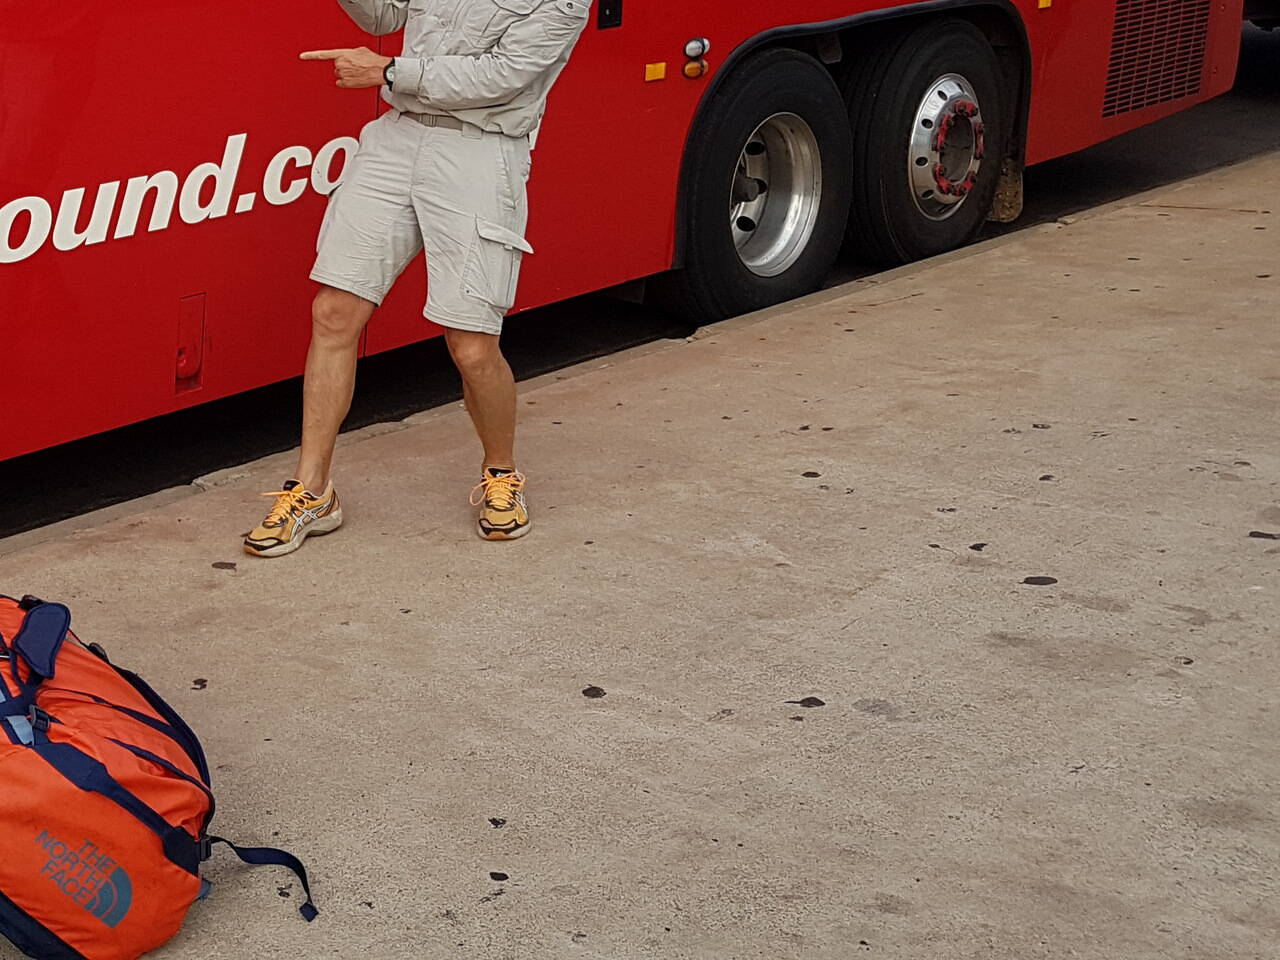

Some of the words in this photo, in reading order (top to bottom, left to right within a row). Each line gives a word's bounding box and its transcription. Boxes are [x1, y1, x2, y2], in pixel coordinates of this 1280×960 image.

[34, 829, 106, 891] NORTH
[78, 839, 118, 873] THE
[40, 859, 95, 905] FACE
